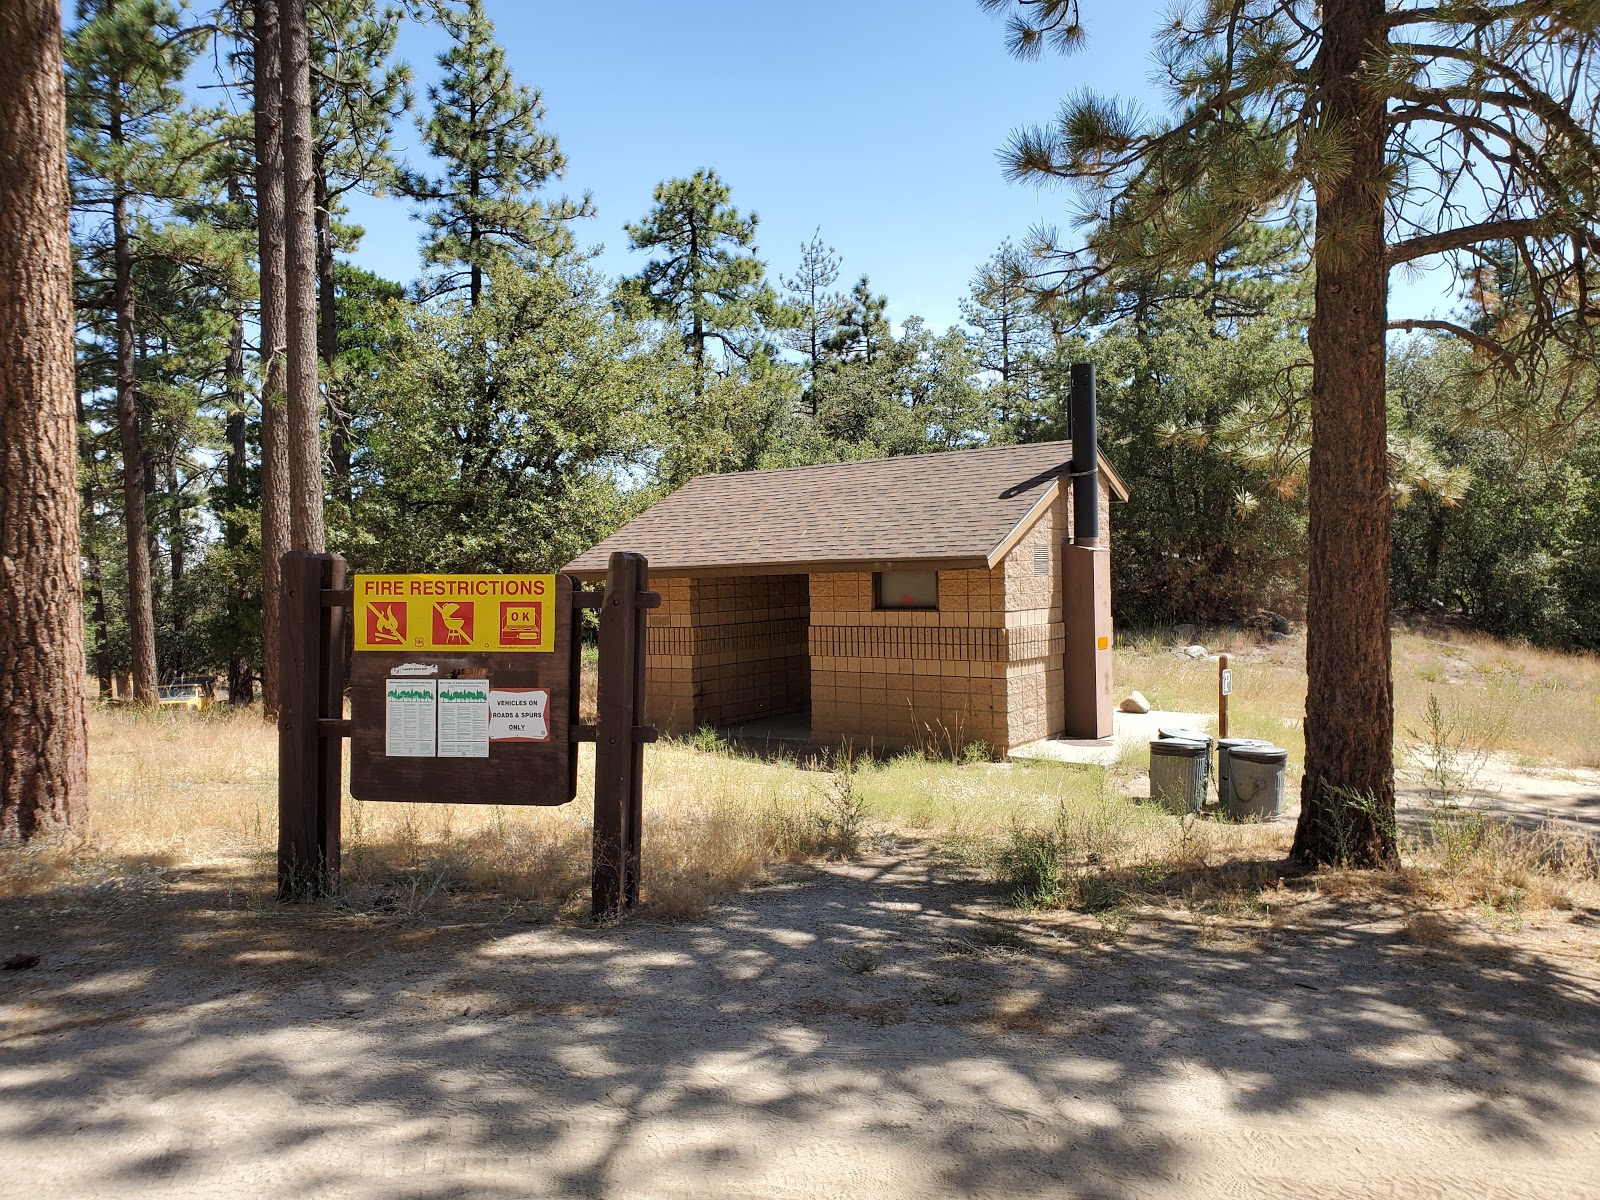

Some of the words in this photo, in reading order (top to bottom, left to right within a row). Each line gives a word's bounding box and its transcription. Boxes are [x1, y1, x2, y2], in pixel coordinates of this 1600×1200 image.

[365, 580, 404, 596] FIRE
[410, 580, 545, 596] RESTRICTIONS
[1224, 672, 1230, 692] P
